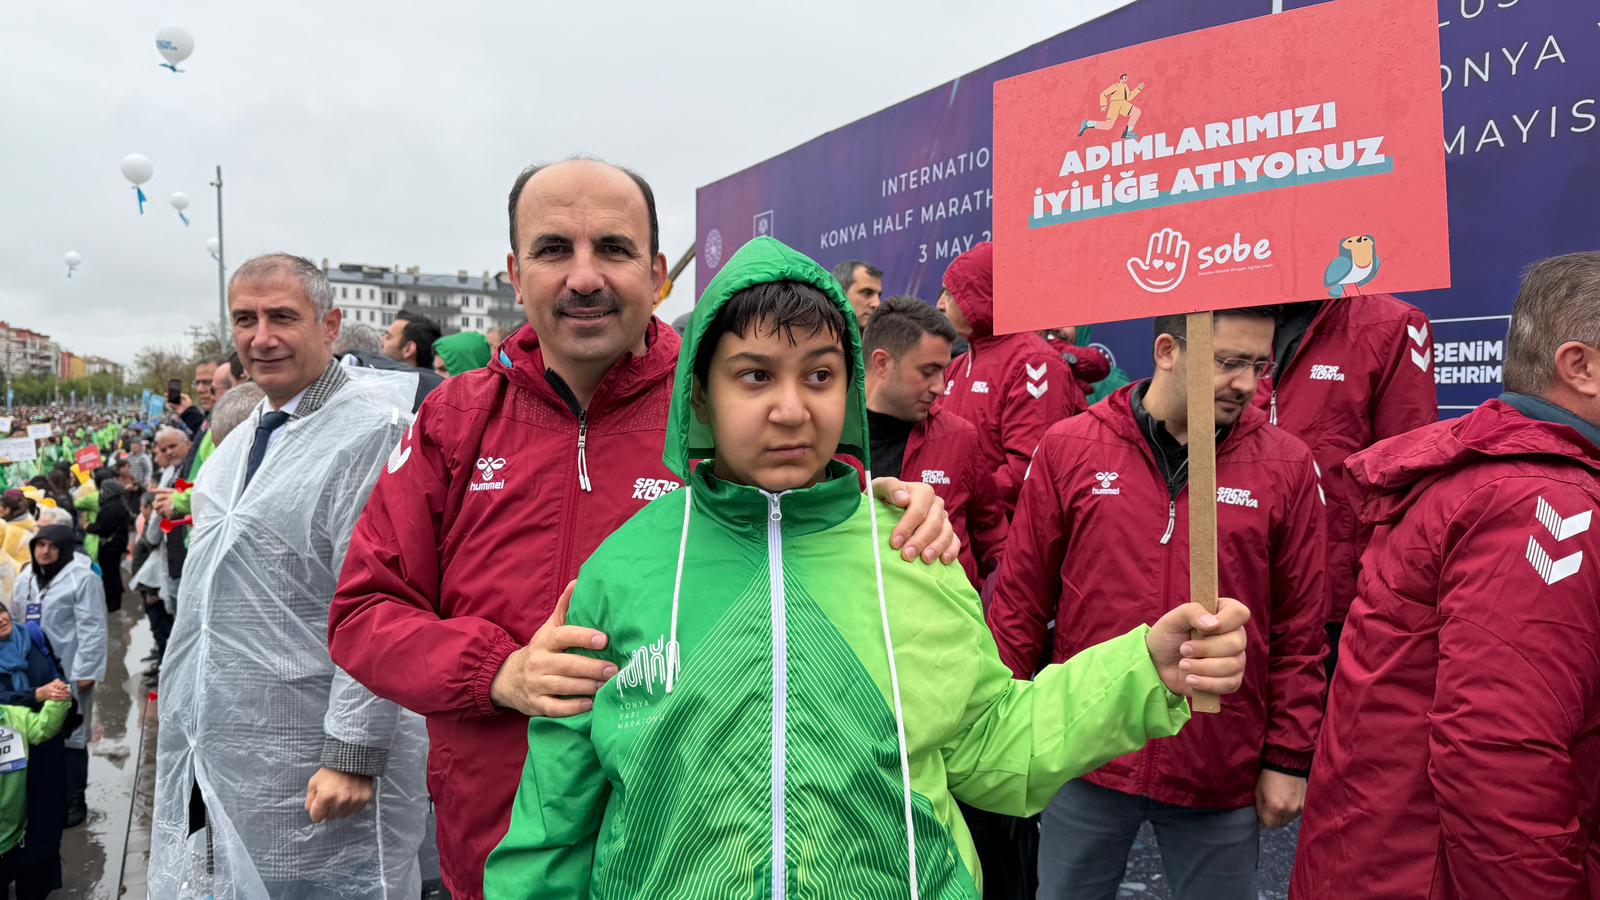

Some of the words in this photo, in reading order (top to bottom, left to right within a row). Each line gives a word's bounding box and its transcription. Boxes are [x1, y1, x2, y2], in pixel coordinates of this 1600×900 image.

[1058, 101, 1337, 177] ADIMLARIMIZI
[881, 147, 991, 198] INTERNATIO
[1033, 169, 1160, 219] İYİLİĞE
[1169, 136, 1385, 196] ATIYORUZ
[820, 222, 867, 249] KONYA
[872, 209, 914, 237] HALF
[920, 188, 993, 225] MARATH
[918, 243, 928, 263] 3
[935, 233, 974, 260] MAY
[1197, 232, 1272, 270] sobe
[469, 479, 505, 492] hummel
[1092, 486, 1120, 496] hummel
[1216, 494, 1259, 509] KONYA
